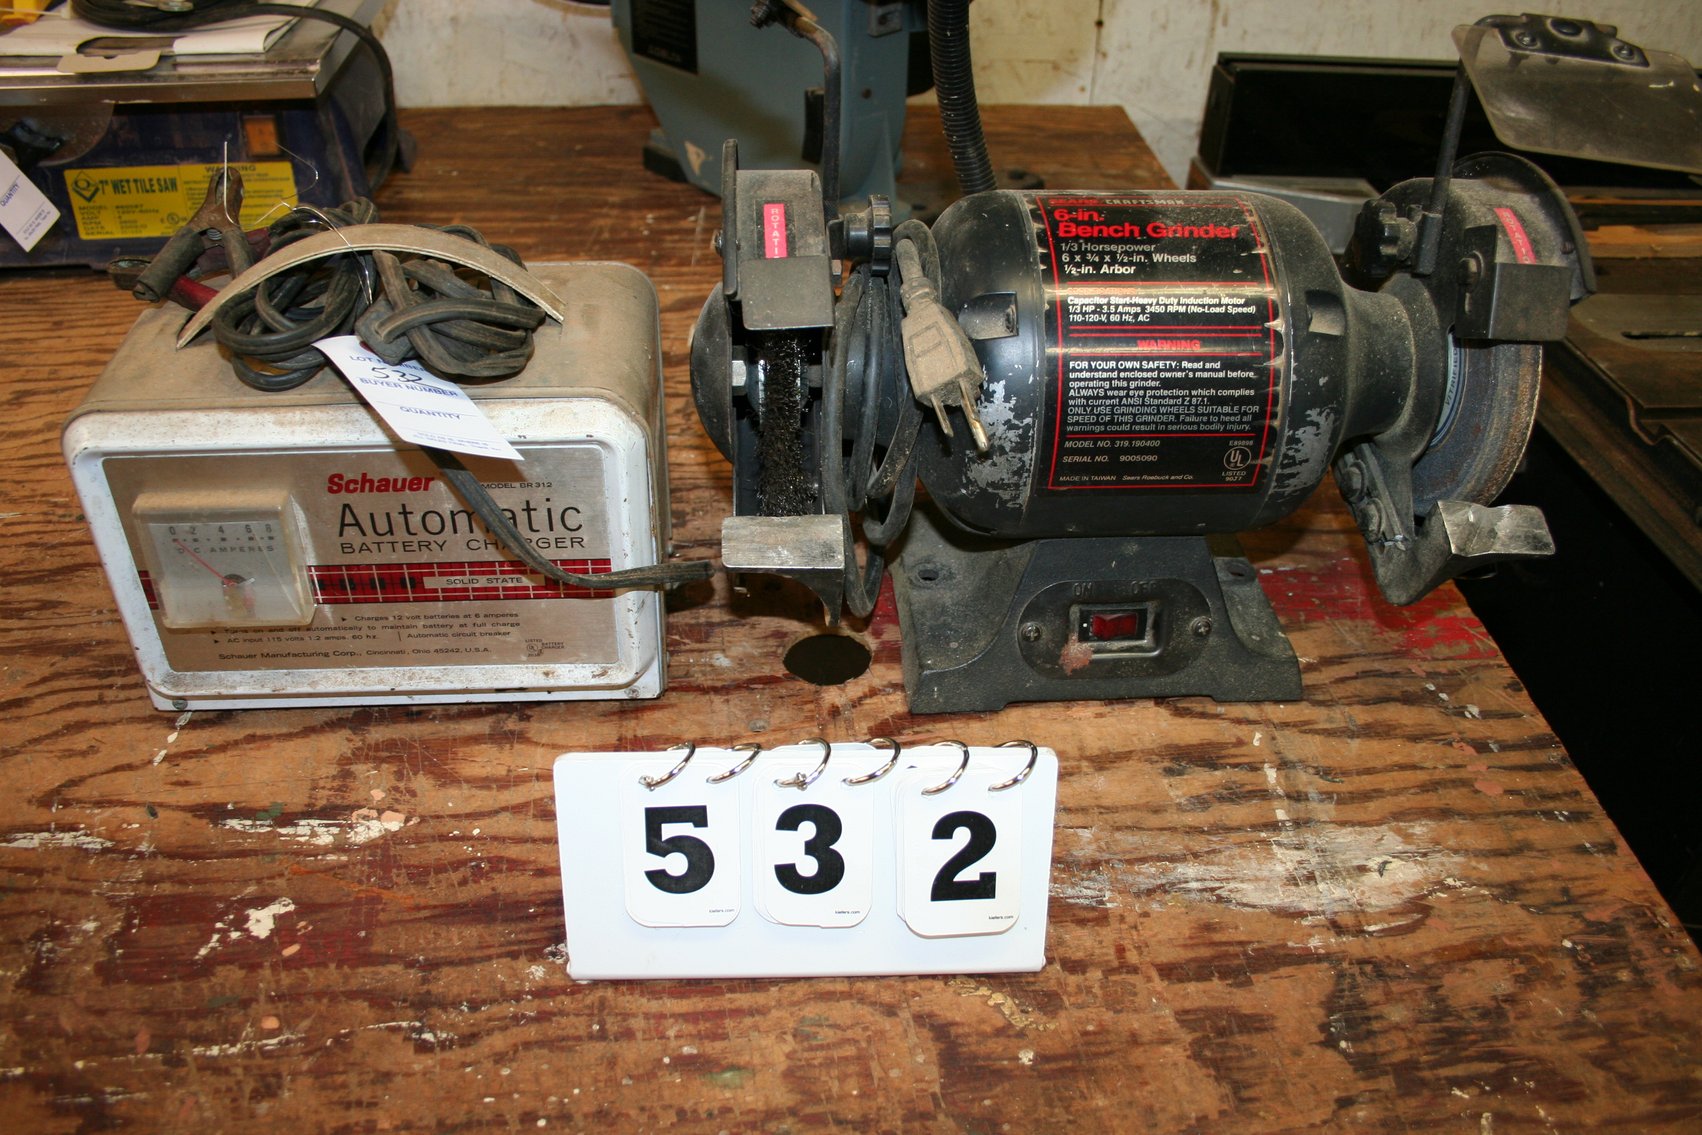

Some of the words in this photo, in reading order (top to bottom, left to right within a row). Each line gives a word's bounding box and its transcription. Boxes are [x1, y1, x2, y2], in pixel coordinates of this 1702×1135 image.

[99, 179, 109, 195] 7"
[111, 179, 132, 195] WET
[133, 178, 155, 194] TILE
[157, 177, 178, 194] SAW
[1053, 208, 1105, 221] 6-in.
[771, 208, 780, 259] ROTATI
[1058, 222, 1140, 238] Bench
[1146, 222, 1240, 239] Grinder
[1060, 243, 1078, 252] 1/3
[1081, 242, 1157, 253] Horsepower
[1061, 253, 1070, 262] 6
[1152, 253, 1197, 262] Wheels
[1100, 264, 1137, 274] Arbor
[1067, 296, 1109, 305] Capacitor
[1110, 296, 1157, 305] Start-Heavy
[1158, 296, 1179, 305] Duty
[1180, 297, 1219, 305] Induction
[1068, 305, 1080, 313] 1/3
[1082, 305, 1095, 313] HP
[1102, 305, 1116, 313] 3.5
[1117, 306, 1141, 314] Amps
[1144, 305, 1165, 313] 3450
[1167, 305, 1186, 313] RPM
[1187, 305, 1225, 314] (No-Load
[1227, 305, 1256, 315] Speed)
[1069, 314, 1108, 322] 110-120-V,
[1122, 314, 1135, 322] Hz,
[1137, 339, 1201, 350] WARNING
[349, 355, 373, 363] LOT
[1069, 361, 1088, 369] FOR
[1090, 361, 1116, 369] YOUR
[1118, 361, 1140, 369] OWN
[1141, 361, 1180, 369] SAFETY:
[1181, 361, 1203, 369] Read
[1204, 361, 1221, 369] and
[1069, 370, 1118, 378] understand
[1119, 370, 1158, 378] enclosed
[1159, 370, 1193, 378] owner's
[1195, 370, 1225, 378] manual
[1227, 370, 1254, 378] before
[359, 377, 402, 389] BUYER
[406, 384, 459, 397] NUMBER
[1068, 380, 1110, 389] operating
[1111, 379, 1127, 387] this
[1129, 380, 1161, 388] grinder.
[1068, 389, 1105, 397] ALWAYS
[1129, 390, 1144, 398] eye
[1146, 388, 1189, 398] protection
[1191, 388, 1216, 396] which
[1217, 388, 1255, 397] complies
[1120, 397, 1142, 405] ANSI
[1144, 397, 1183, 405] Standard
[400, 405, 462, 420] QUANTITY
[1067, 406, 1091, 415] ONLY
[1093, 406, 1112, 414] USE
[1113, 406, 1157, 414] GRINDING
[1159, 406, 1196, 414] WHEELS
[1197, 405, 1240, 413] SUITABLE
[1241, 405, 1260, 413] FOR
[1067, 415, 1097, 423] SPEED
[1098, 415, 1111, 423] OF
[1180, 414, 1207, 422] Failure
[1220, 414, 1241, 422] heed
[1242, 414, 1252, 422] all
[1066, 424, 1105, 433] warnings
[1131, 423, 1156, 431] result
[1167, 423, 1198, 431] serious
[1199, 423, 1225, 432] bodily
[1226, 423, 1251, 432] injury.
[1064, 440, 1095, 448] MODEL
[1096, 440, 1112, 448] NO.
[1062, 455, 1092, 463] SERIAL
[327, 473, 435, 495] Schauer
[218, 525, 225, 534] 4
[245, 524, 252, 533] 6
[340, 539, 447, 555] BATTERY
[466, 536, 585, 551] CHGER
[446, 577, 479, 585] SOLID
[486, 576, 523, 584] STATE
[260, 651, 331, 659] Manufacturing
[644, 805, 715, 894] 5
[774, 804, 845, 894] 3
[930, 810, 998, 903] 2
